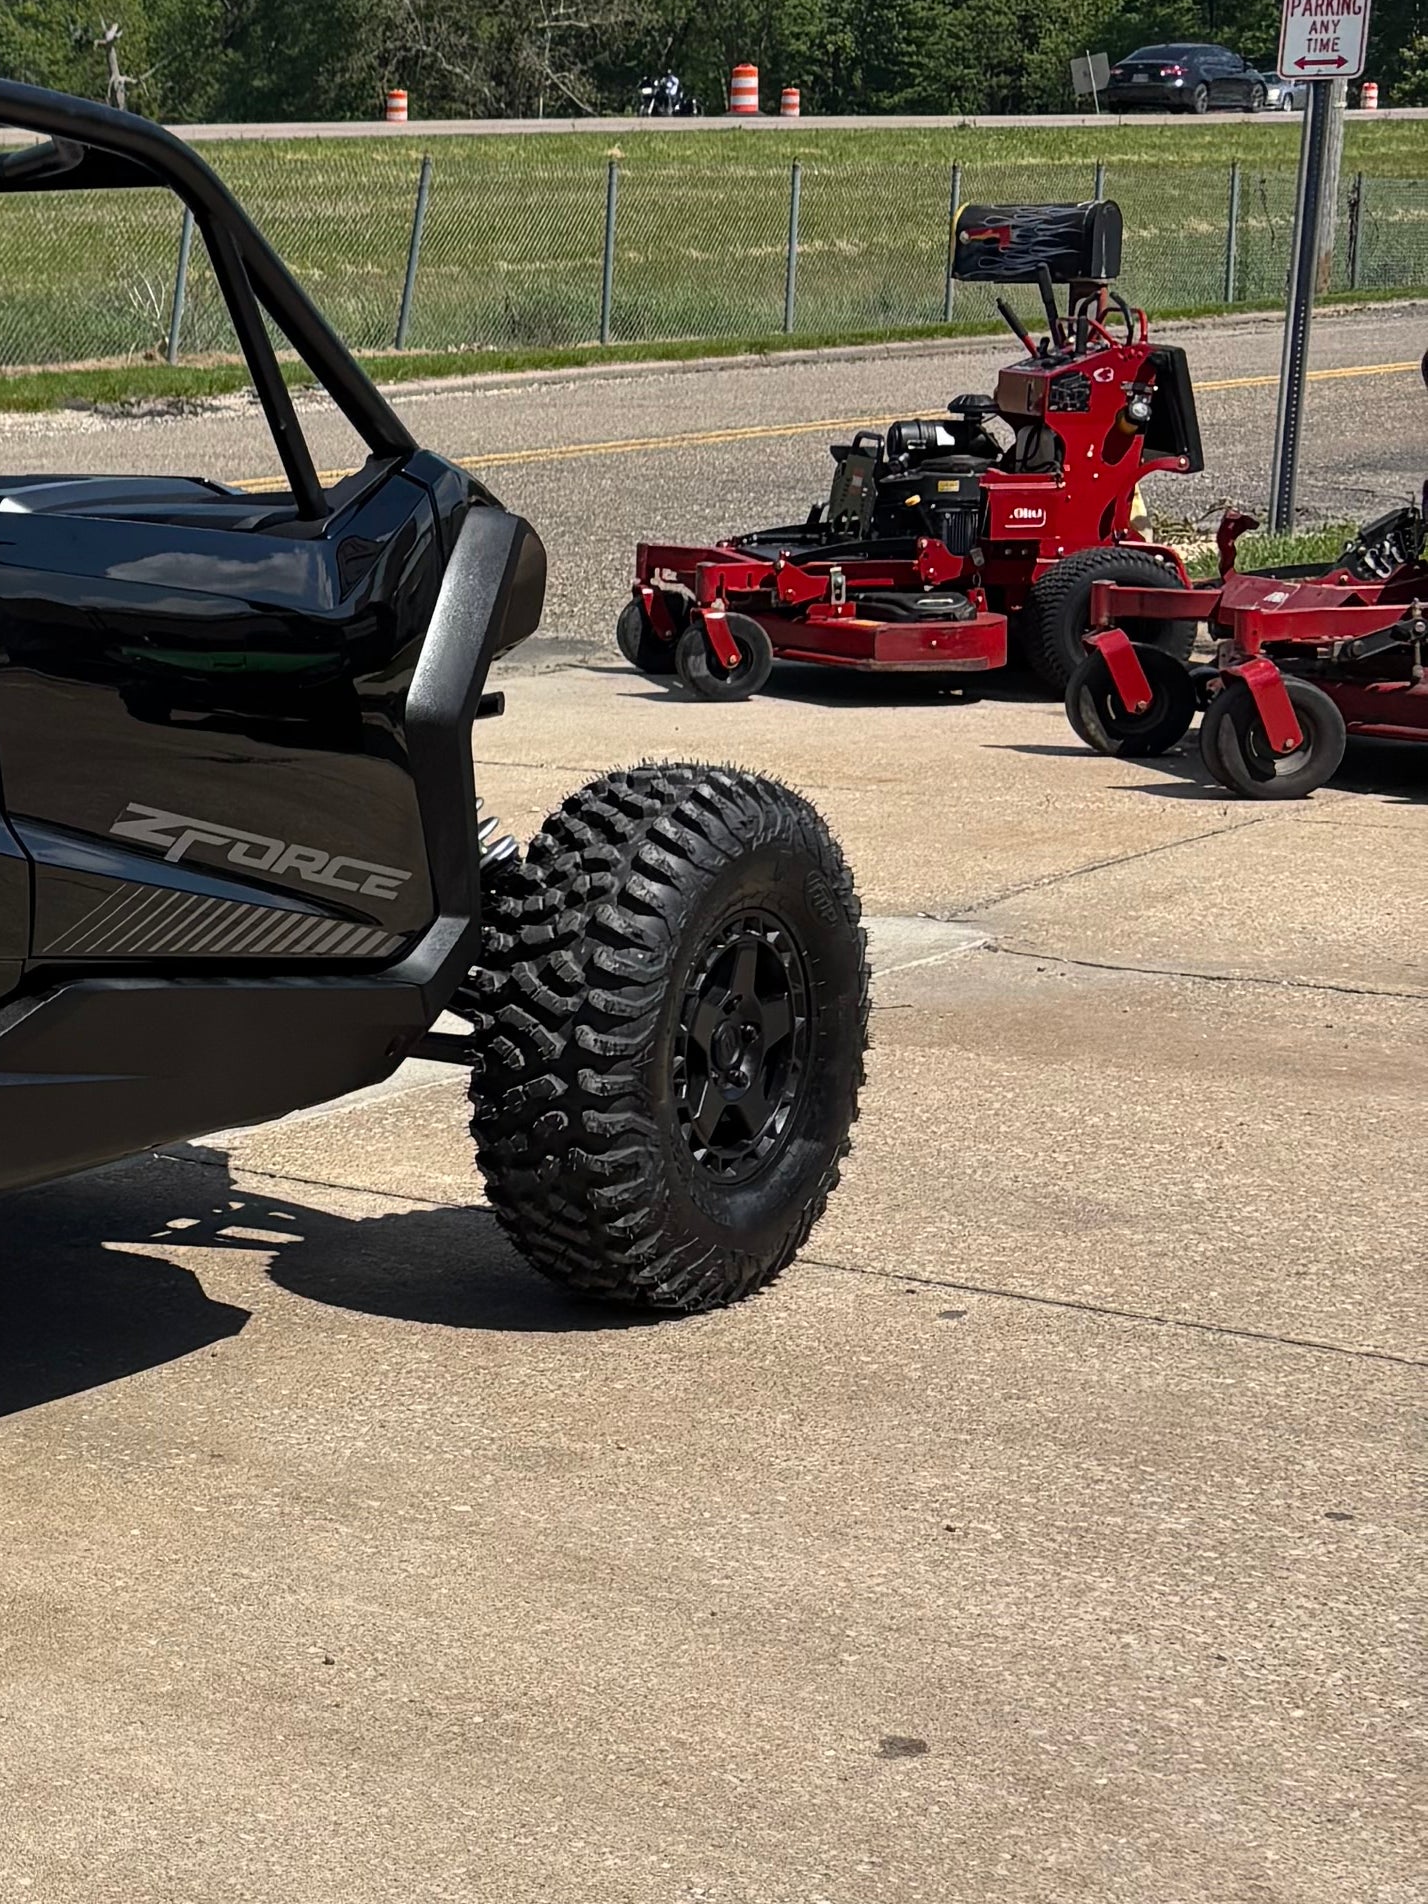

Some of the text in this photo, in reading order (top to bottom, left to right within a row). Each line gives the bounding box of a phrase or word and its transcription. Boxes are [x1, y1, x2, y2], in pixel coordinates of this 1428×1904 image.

[1308, 19, 1341, 36] ANY
[1306, 36, 1341, 54] TIME
[109, 802, 413, 900] ZFORCE
